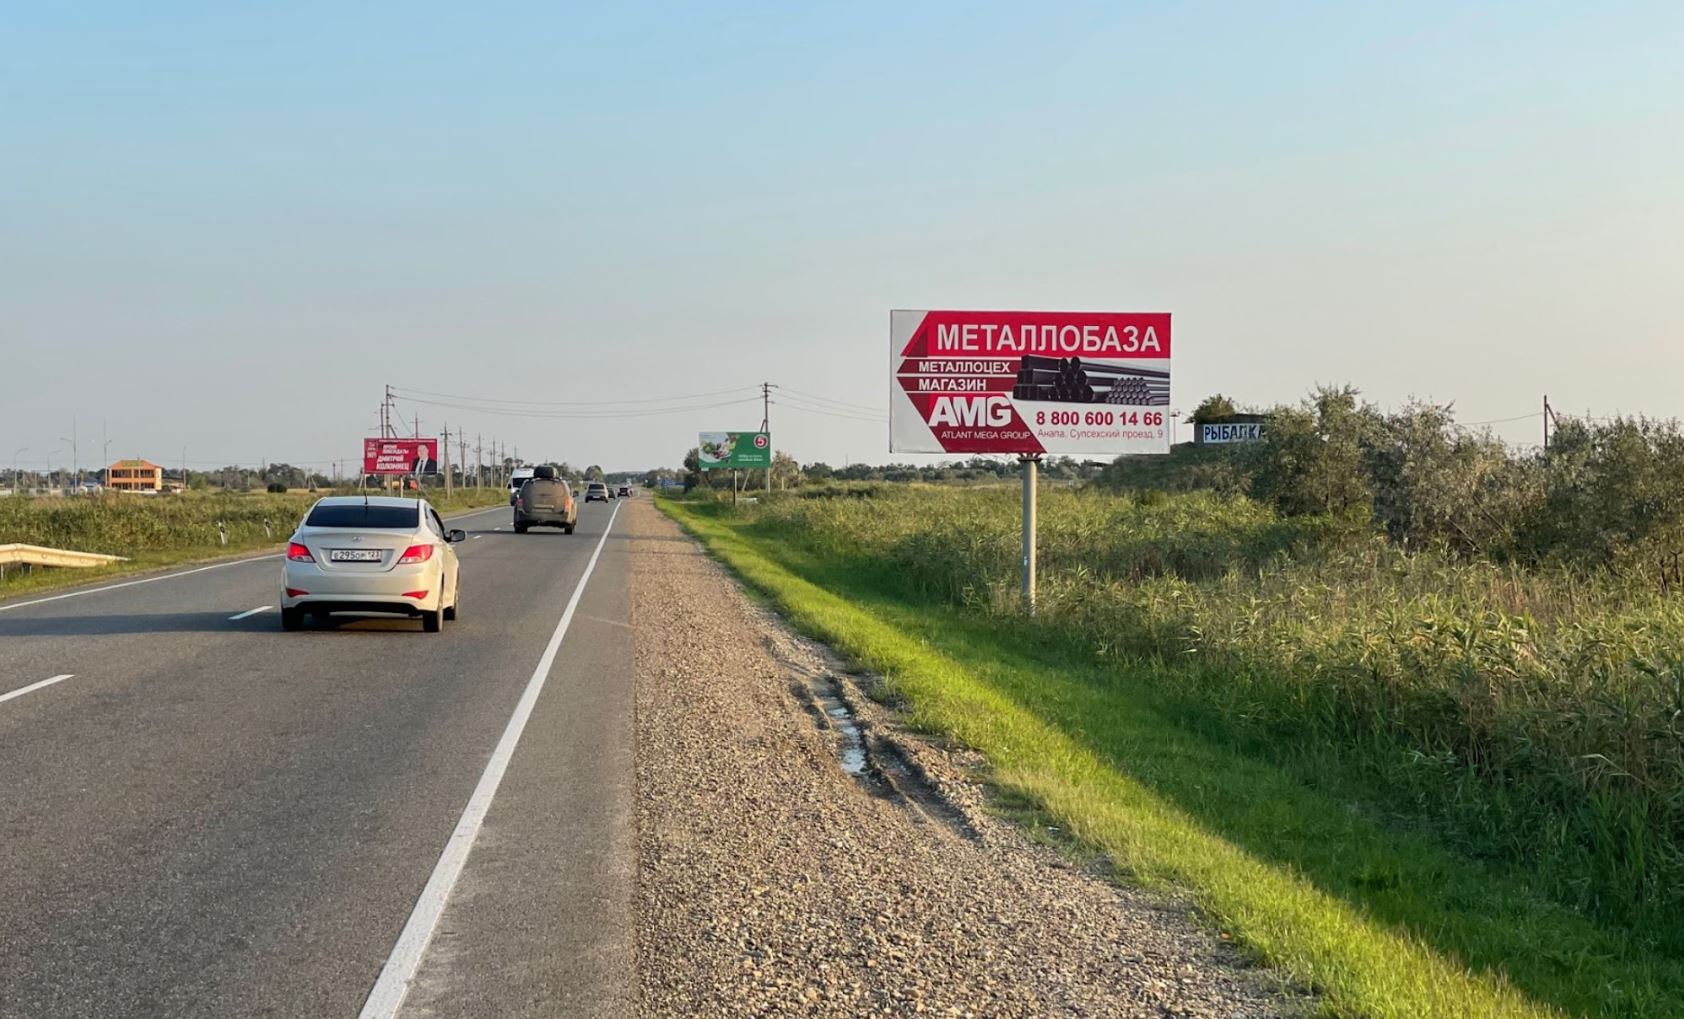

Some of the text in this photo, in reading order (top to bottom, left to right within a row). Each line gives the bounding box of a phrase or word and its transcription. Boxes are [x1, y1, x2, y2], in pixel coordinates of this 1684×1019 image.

[937, 323, 1161, 353] МЕТАЛЛОБАЗА
[918, 361, 1010, 374] МЕТАЛЛОЦЕХ
[918, 379, 987, 391] МАГАЗИН
[928, 396, 1012, 428] AMG
[1036, 411, 1163, 426] 8 800 600 14 66
[941, 431, 1031, 440] ATLANT MEGA GROUP
[1070, 428, 1121, 440] Супсехский
[1157, 430, 1164, 439] 9
